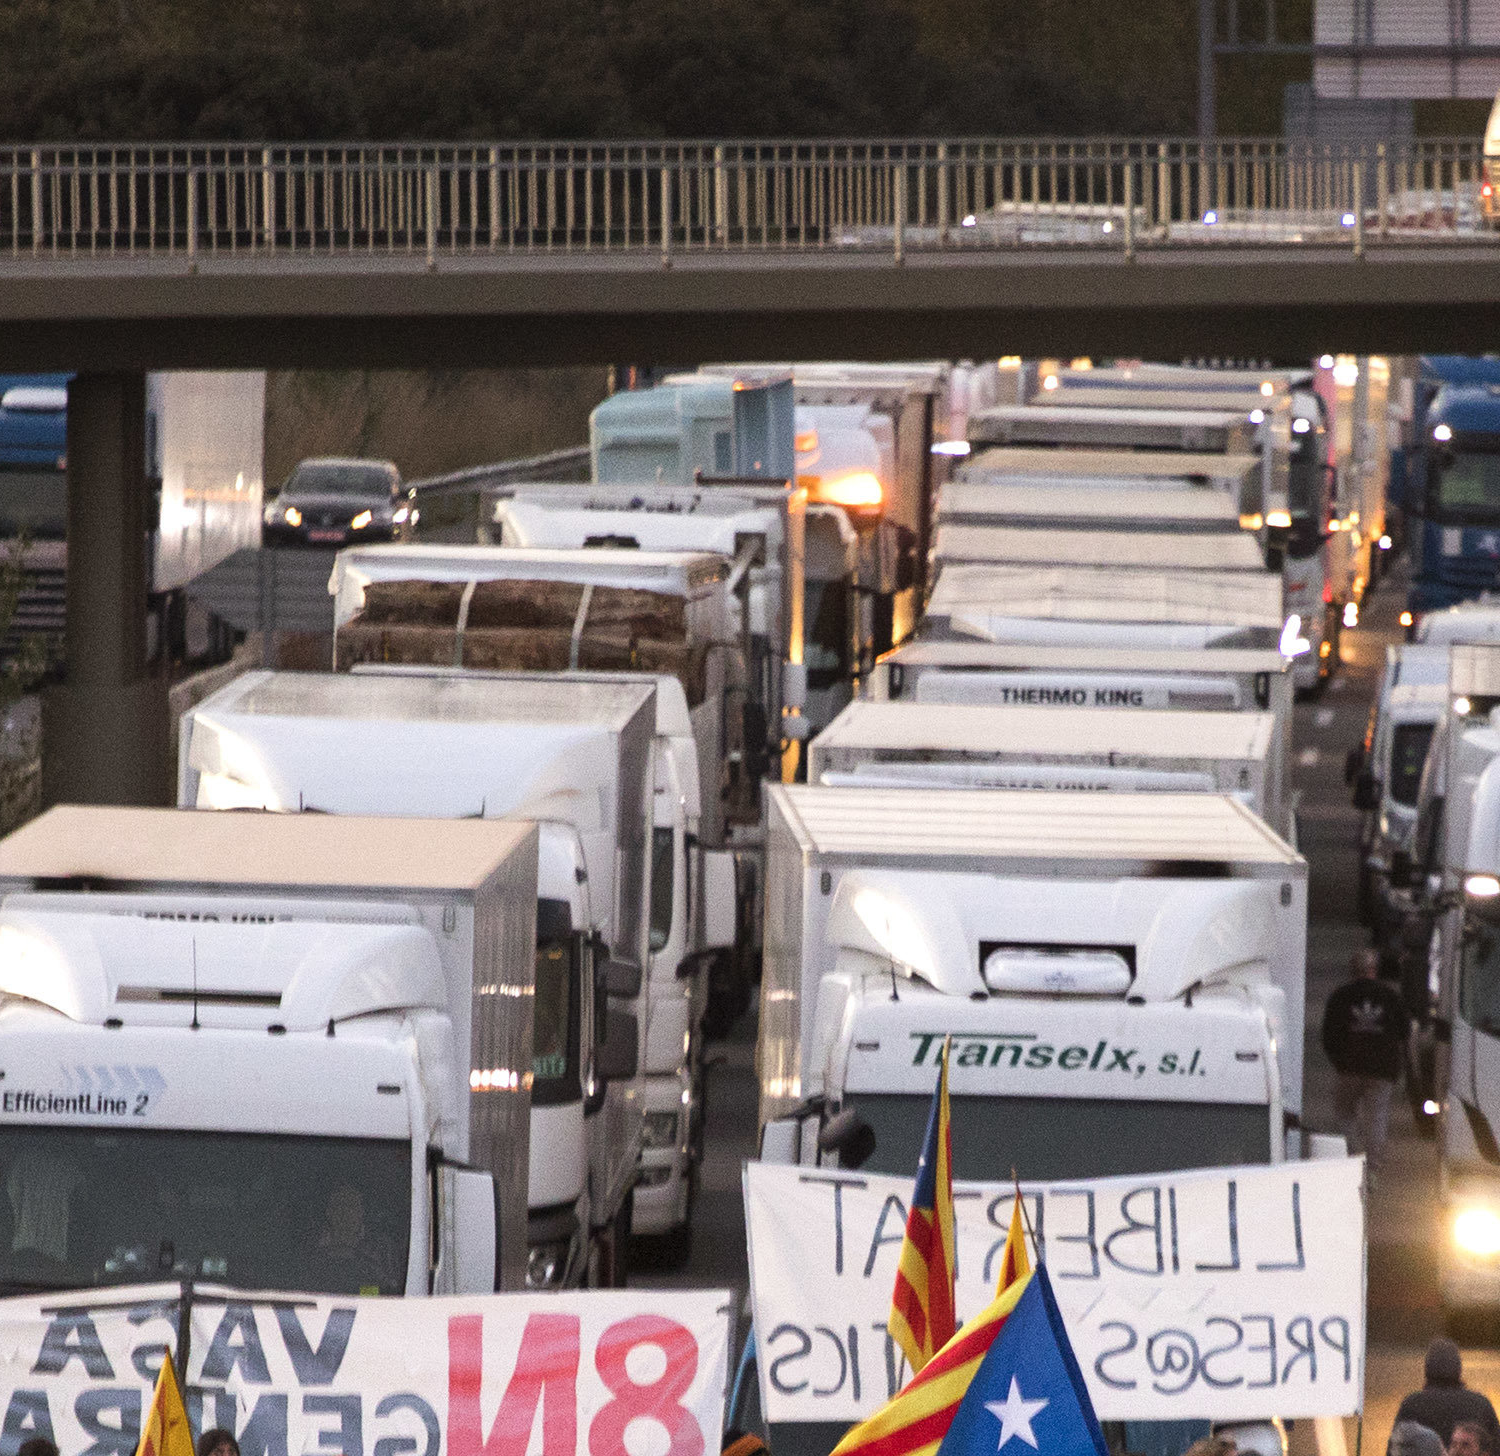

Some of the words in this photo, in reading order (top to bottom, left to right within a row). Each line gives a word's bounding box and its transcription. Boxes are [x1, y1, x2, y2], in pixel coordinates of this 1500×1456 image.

[1001, 687, 1087, 706] THERMO
[1094, 687, 1144, 707] KING
[1157, 1048, 1206, 1076] s.l.
[2, 1090, 128, 1116] EfficientLine
[132, 1090, 150, 1117] 2
